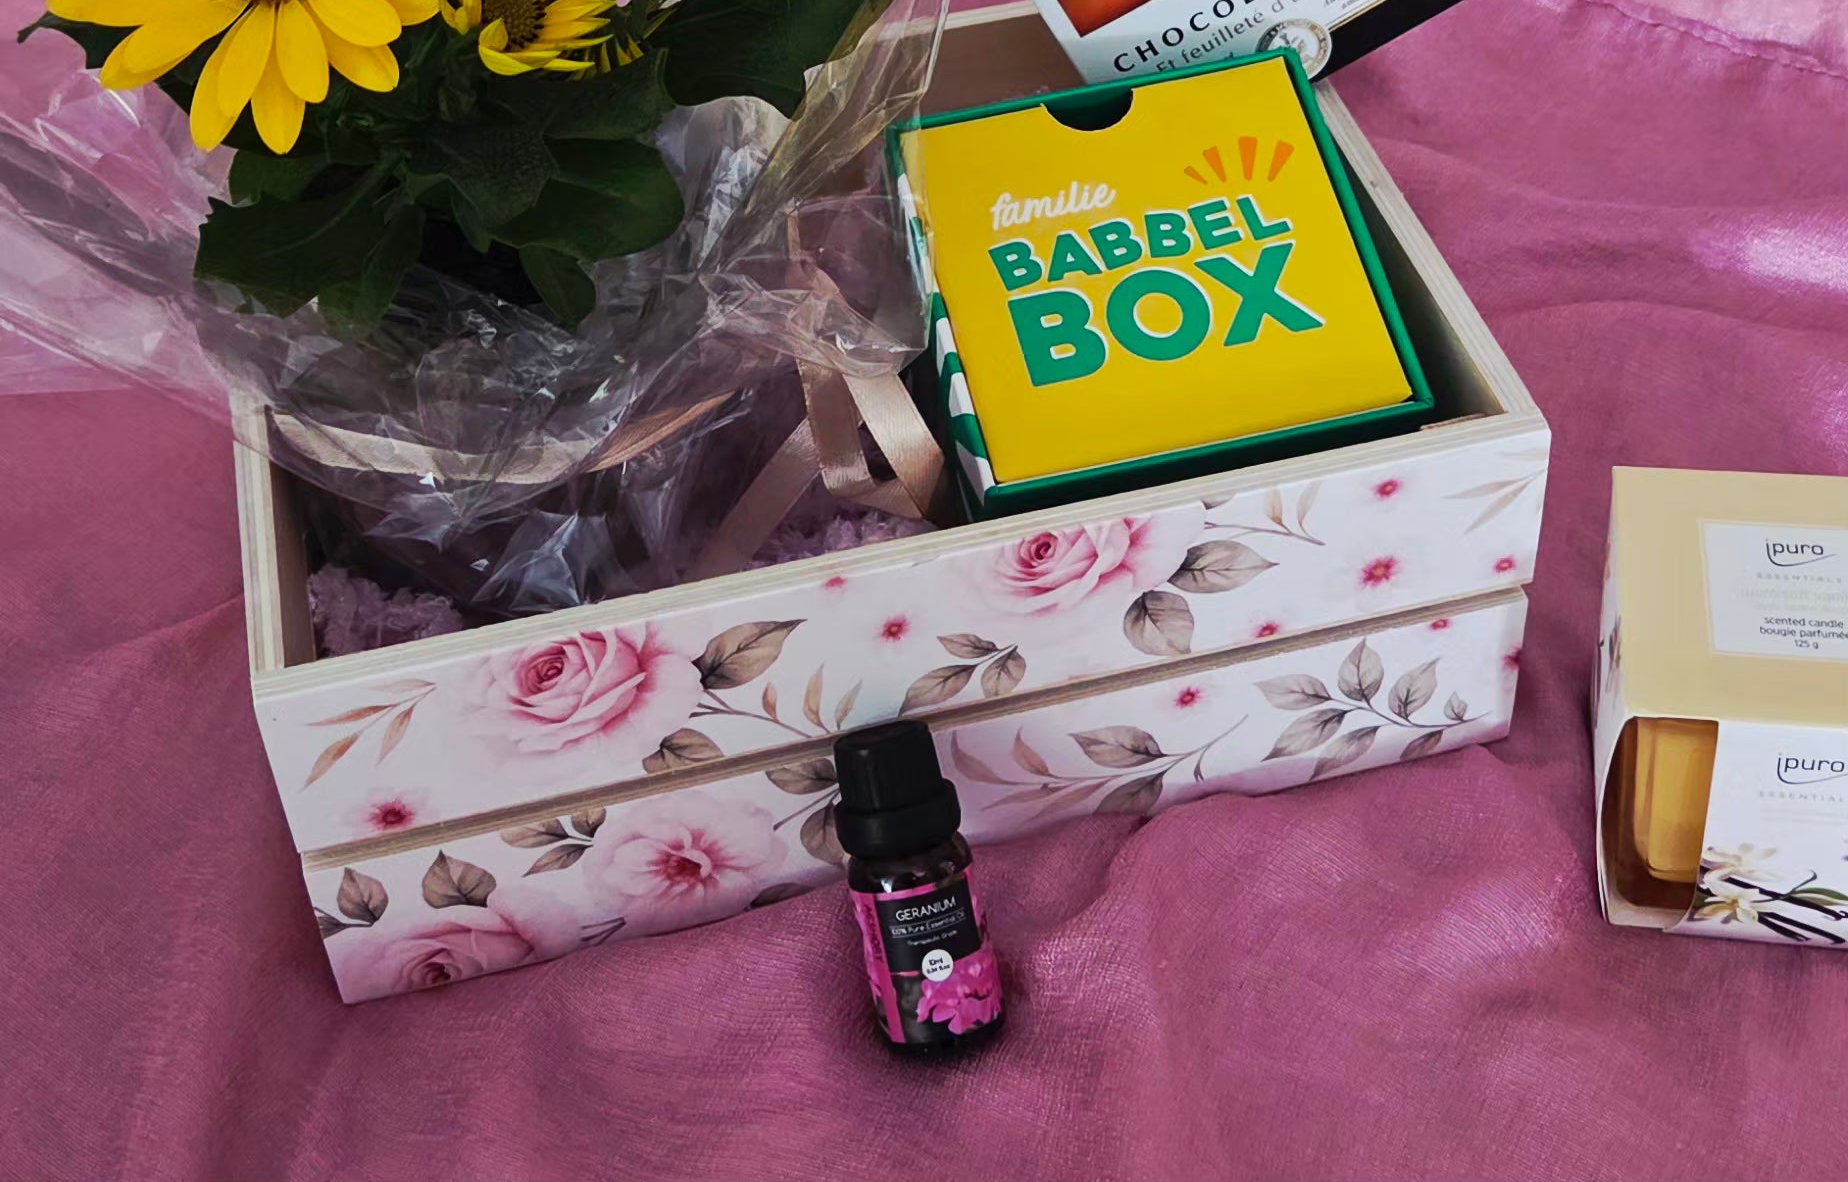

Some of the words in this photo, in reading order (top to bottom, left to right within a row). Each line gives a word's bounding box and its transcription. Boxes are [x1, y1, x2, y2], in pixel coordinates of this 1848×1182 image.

[1181, 9, 1264, 63] feuilleté
[989, 181, 1117, 230] familie
[988, 194, 1293, 292] BABBEL
[1007, 240, 1326, 388] BOX
[1765, 538, 1827, 567] ipuro
[1759, 626, 1796, 637] bougie
[1764, 616, 1806, 627] scented
[1808, 619, 1844, 629] candle
[1794, 639, 1810, 649] 125
[1777, 752, 1846, 784] ipuro
[895, 896, 957, 921] GERANIUM
